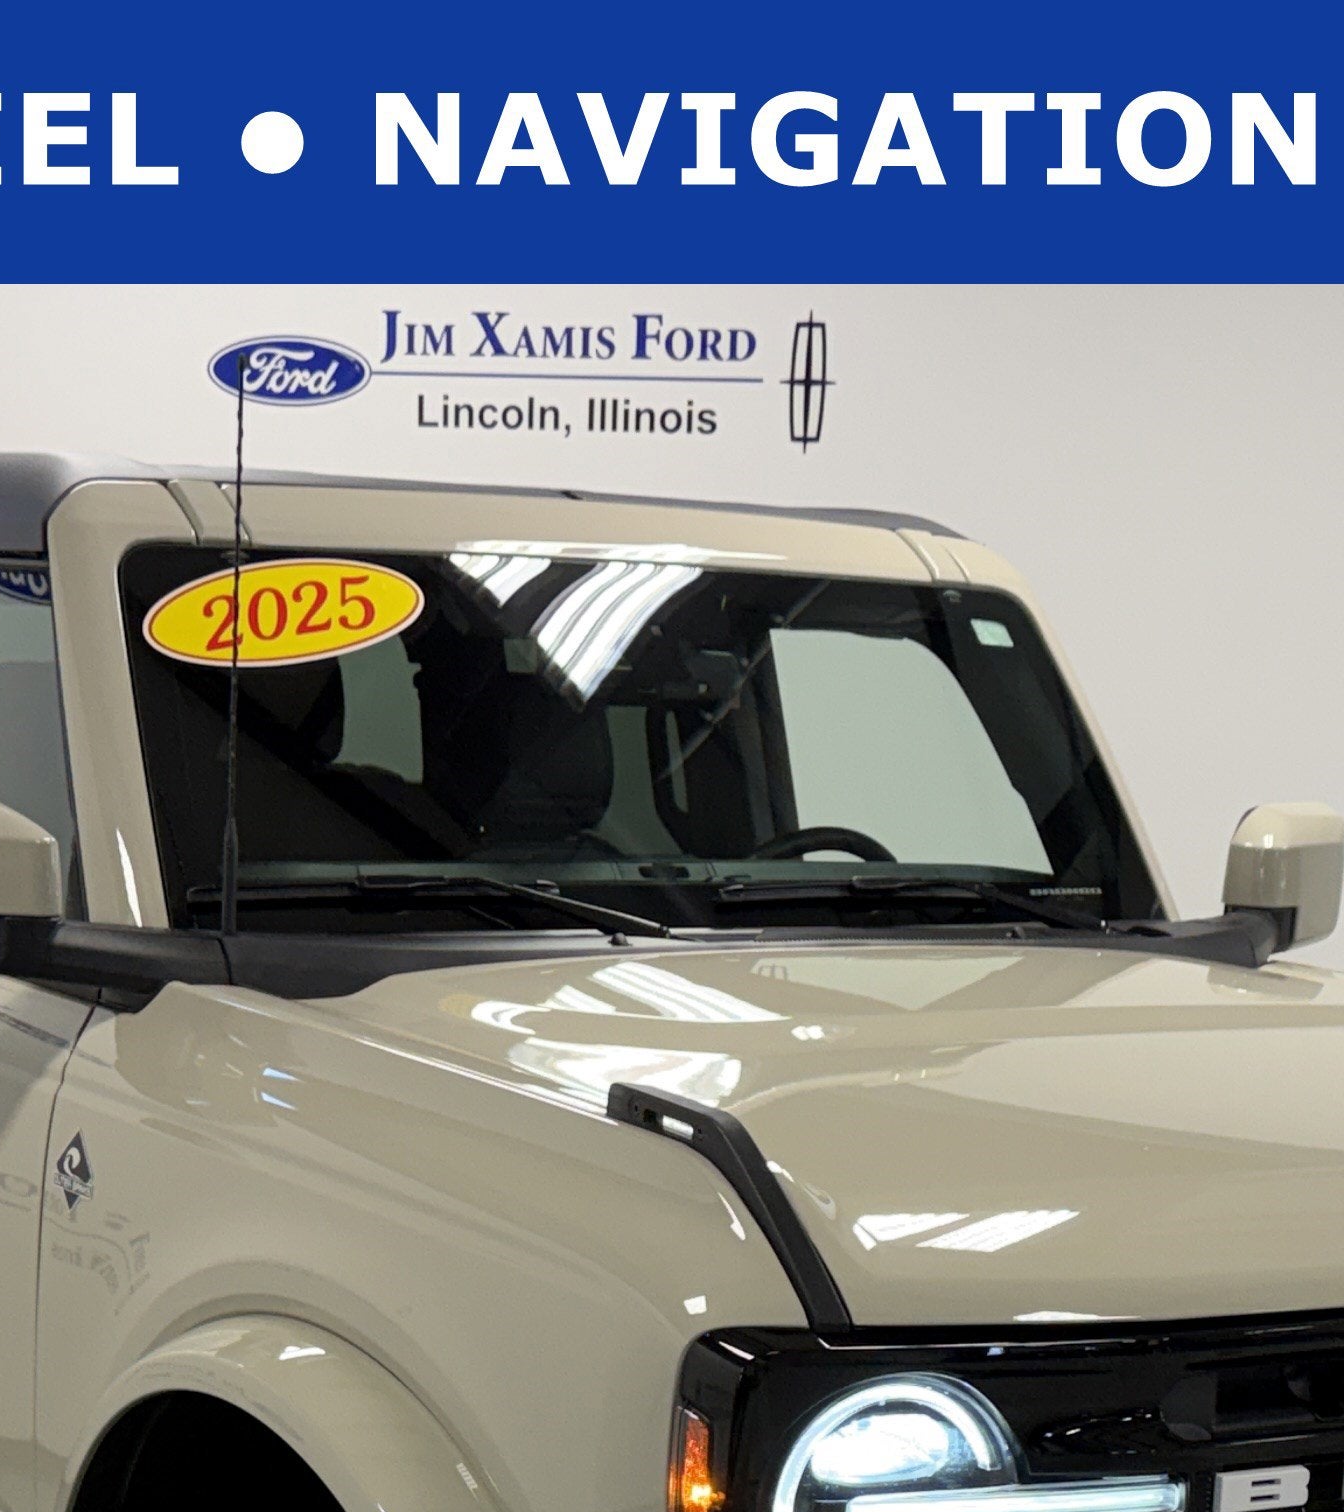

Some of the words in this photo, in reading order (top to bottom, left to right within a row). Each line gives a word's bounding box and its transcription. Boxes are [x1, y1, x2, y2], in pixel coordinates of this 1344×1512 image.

[381, 310, 454, 363] JIM
[471, 311, 616, 361] XAMIS
[632, 314, 757, 362] FORD
[241, 347, 338, 396] Ford
[418, 394, 572, 437] Lincoln,
[587, 398, 718, 436] Illinois
[202, 575, 376, 652] 2025
